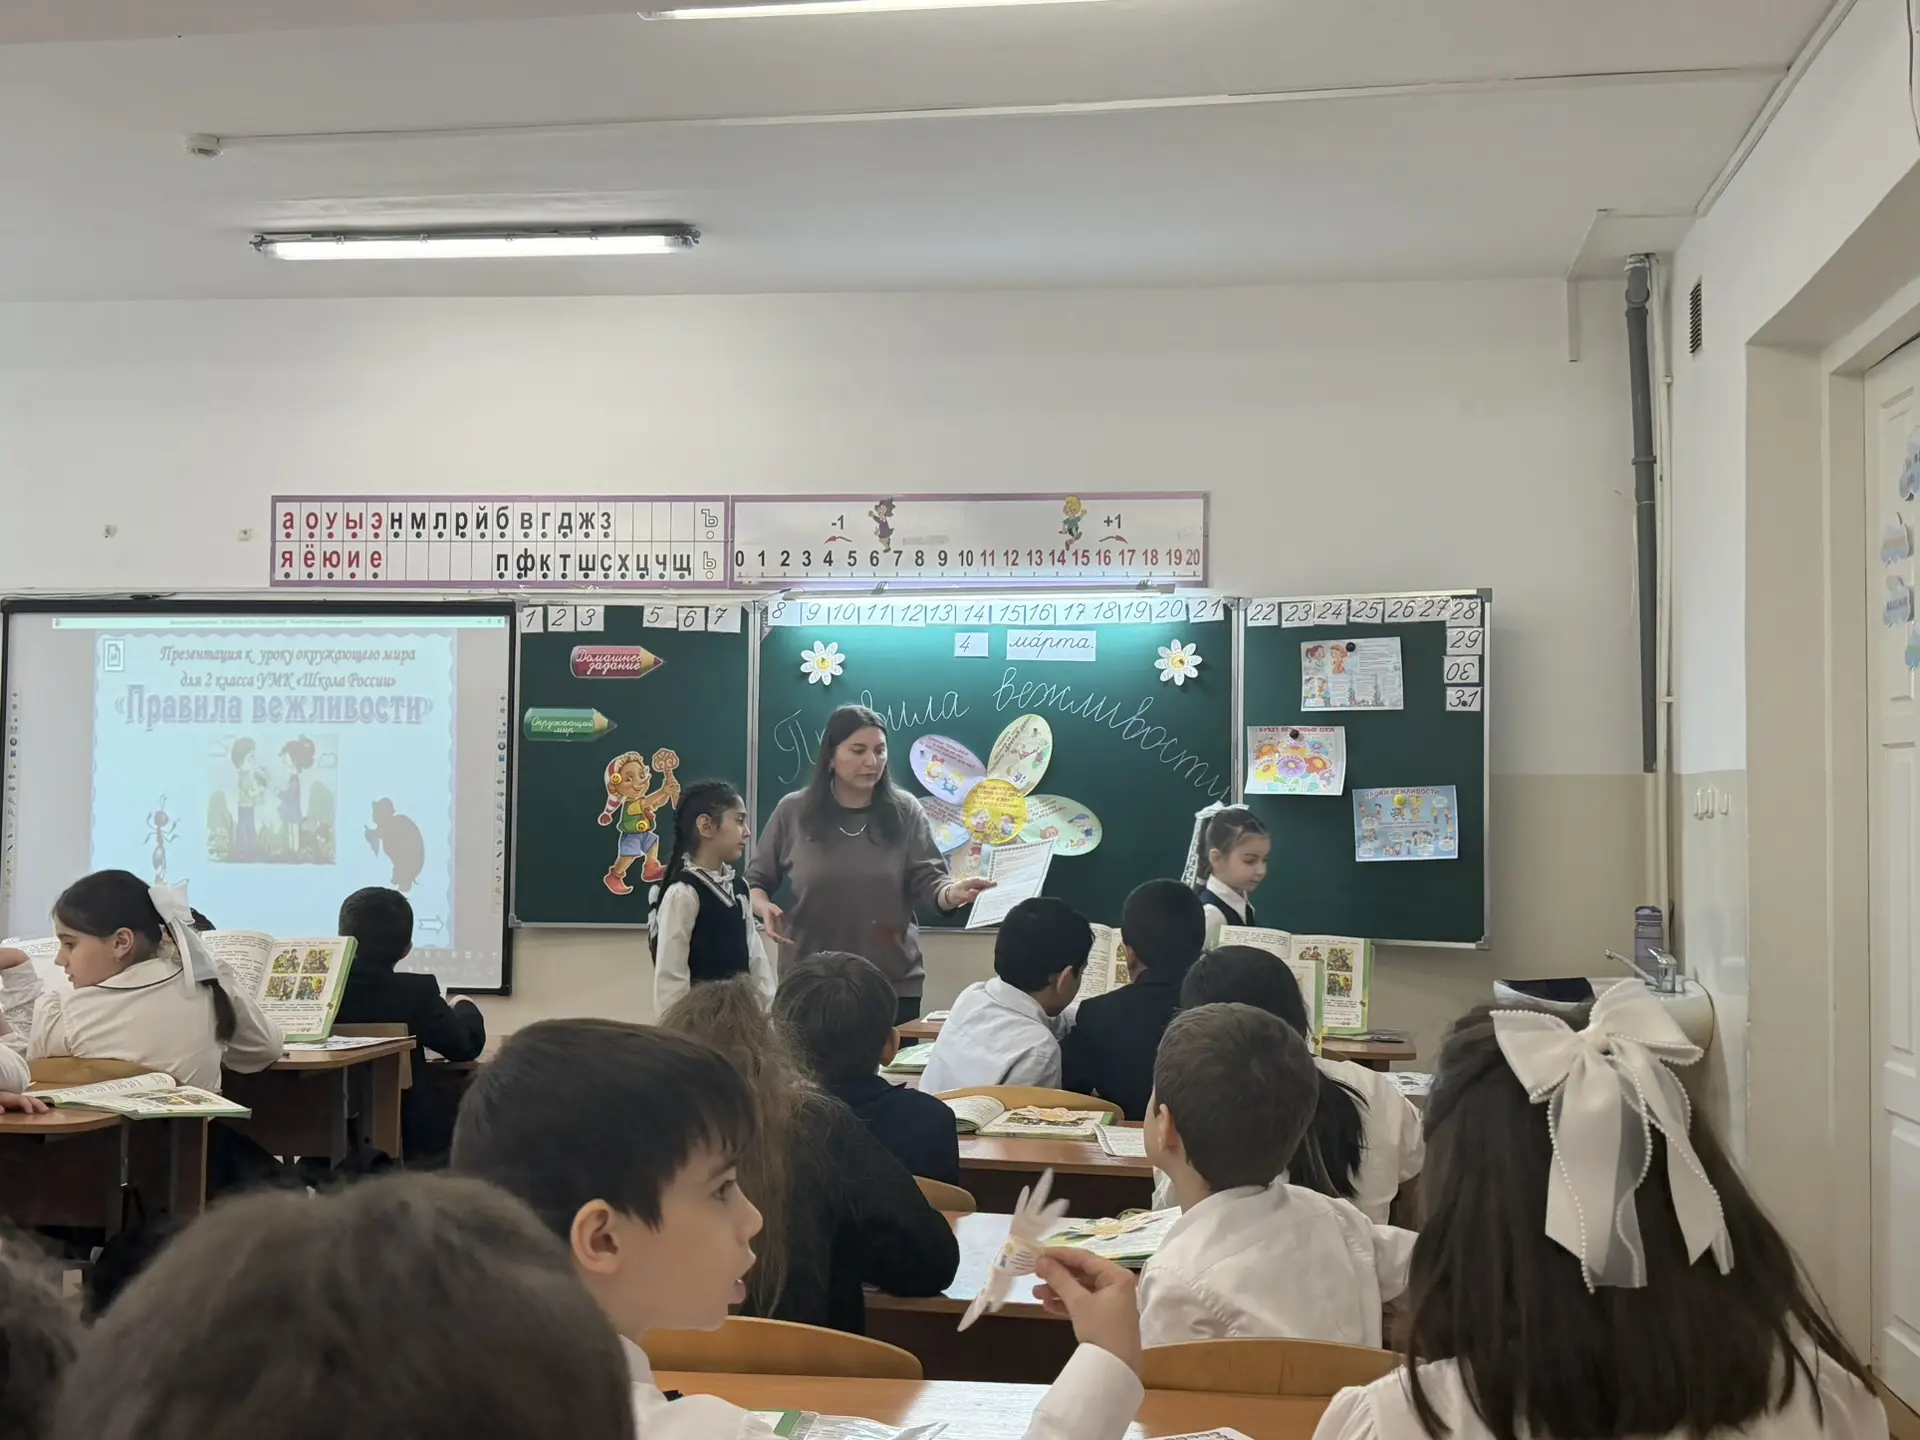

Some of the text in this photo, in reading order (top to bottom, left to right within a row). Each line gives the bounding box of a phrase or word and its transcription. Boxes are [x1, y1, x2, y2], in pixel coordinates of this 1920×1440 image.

[831, 515, 844, 529] -1
[1104, 514, 1121, 528] +1
[735, 549, 1200, 566] 0 1 2 3 4 5 6 7 8 9 10 11 12 13 14 15 16 17 18 19 20
[526, 606, 727, 628] 1 2 3 5 6 7
[772, 599, 1222, 622] 8 9 10 11 12 13 14 15 16 17 18 19 20 21
[1250, 600, 1479, 622] 22 23 24 25 26 27 28
[959, 635, 971, 652] 4
[1450, 631, 1482, 648] 29
[382, 649, 416, 665] мира
[576, 649, 643, 663] Домашнее
[586, 661, 641, 675] задание
[204, 672, 212, 687] 2
[215, 676, 254, 691] класса
[531, 715, 594, 729] Окружающий
[554, 727, 575, 737] мир
